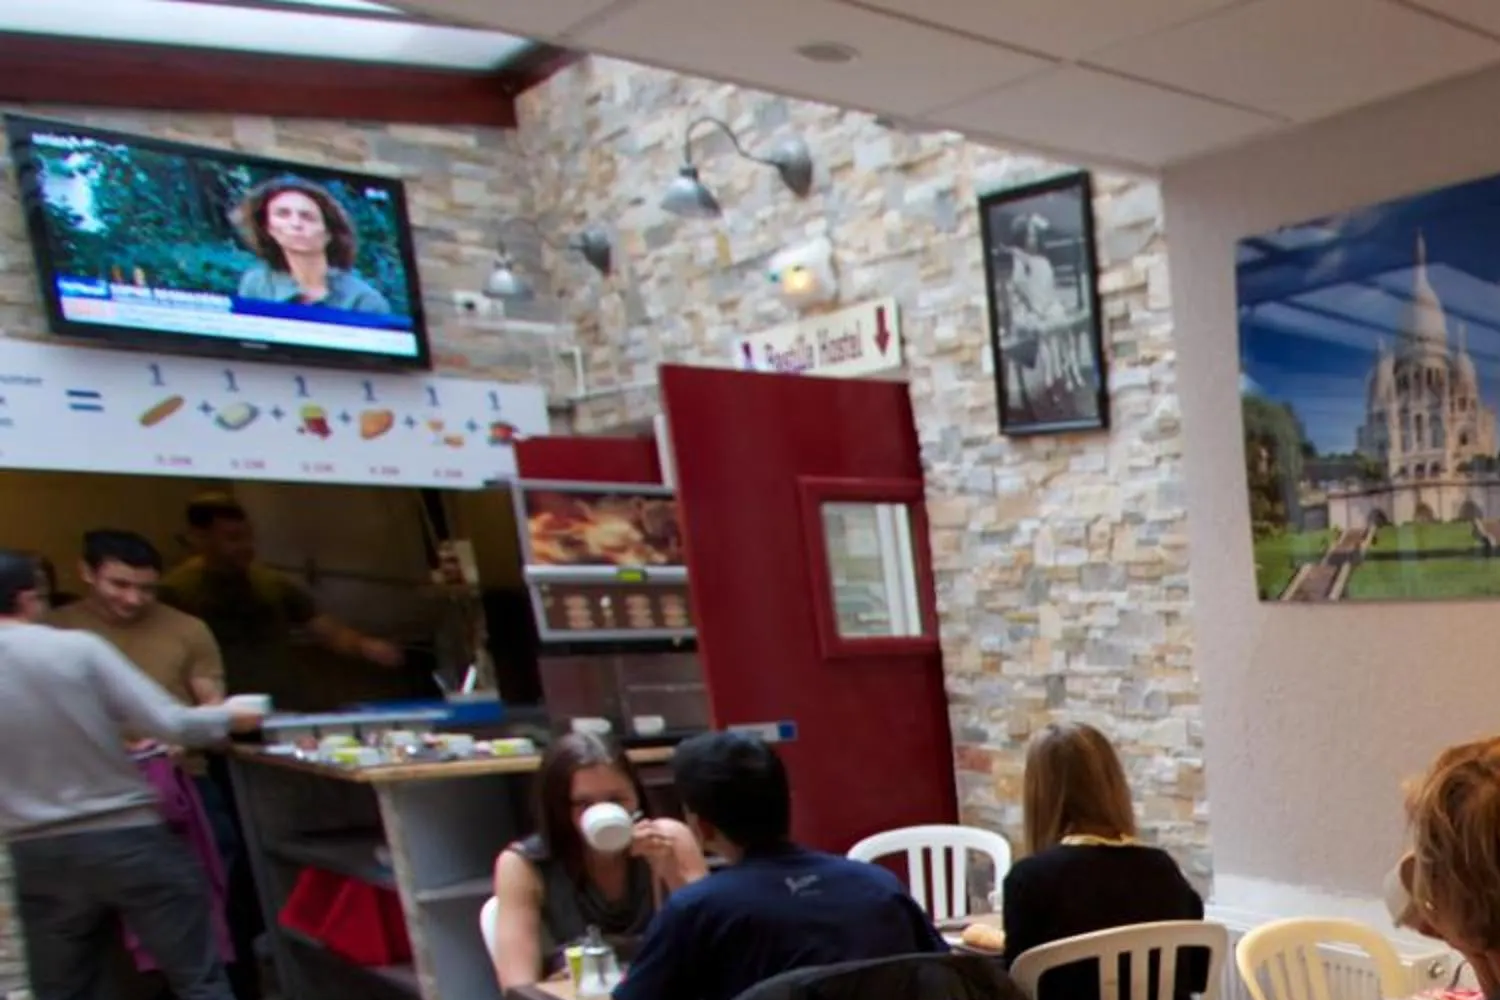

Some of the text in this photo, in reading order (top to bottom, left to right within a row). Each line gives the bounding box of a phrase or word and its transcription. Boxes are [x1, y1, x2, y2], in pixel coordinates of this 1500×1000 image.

[148, 362, 502, 412] 1 1 1 1 1 1
